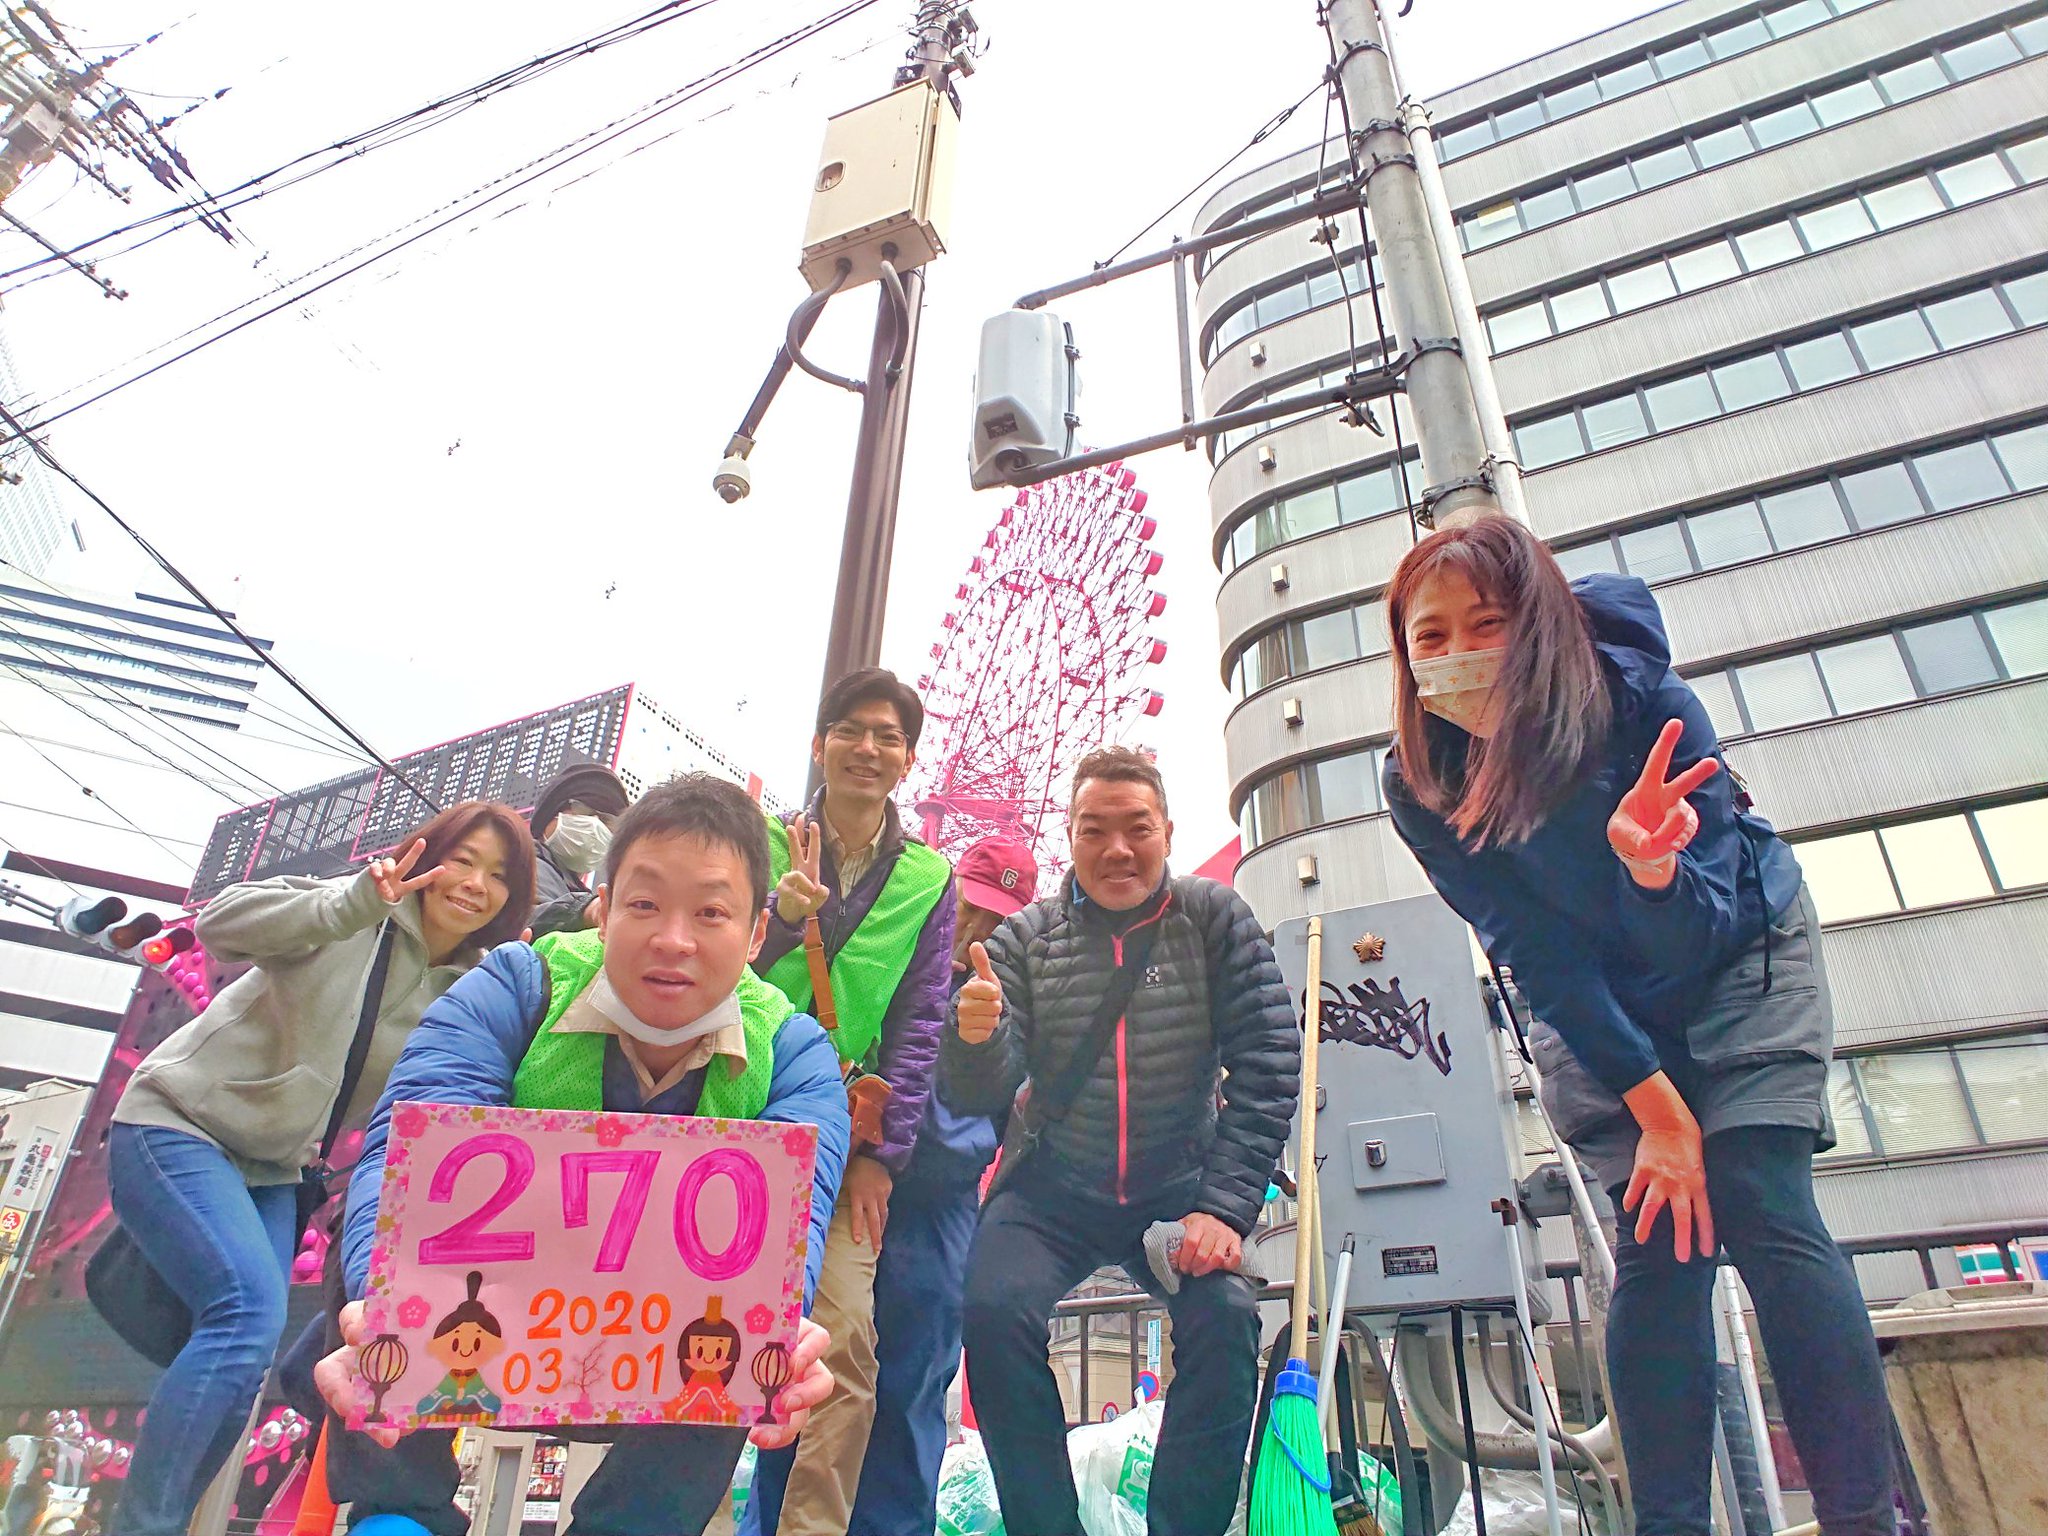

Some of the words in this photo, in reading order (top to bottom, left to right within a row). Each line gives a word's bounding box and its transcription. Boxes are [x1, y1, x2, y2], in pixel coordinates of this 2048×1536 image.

[1000, 867, 1019, 889] G
[418, 1133, 770, 1282] 270
[527, 1289, 672, 1339] 2020
[503, 1348, 563, 1396] 03
[611, 1343, 665, 1393] 01
